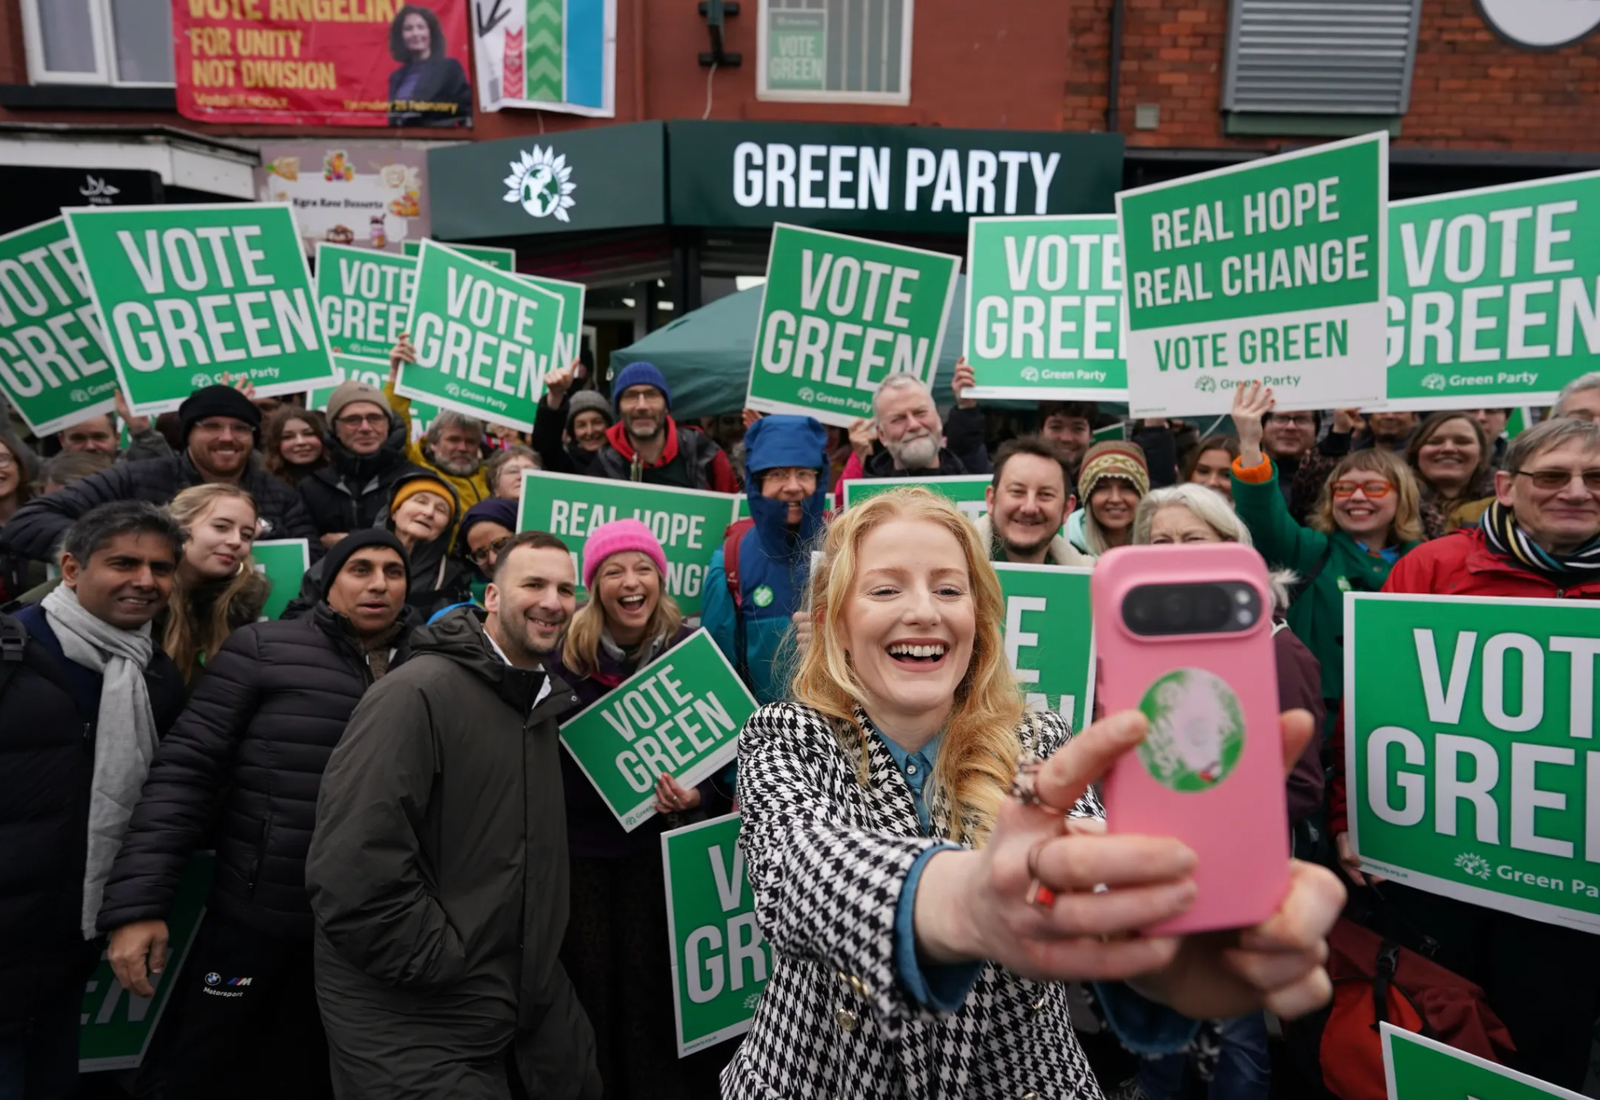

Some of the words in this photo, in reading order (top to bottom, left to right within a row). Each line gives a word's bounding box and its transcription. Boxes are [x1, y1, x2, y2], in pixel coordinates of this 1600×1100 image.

[188, 0, 264, 20] VOTE
[190, 27, 234, 56] FOR
[236, 28, 303, 58] UNITY
[770, 57, 823, 80] GREEN
[778, 35, 815, 56] VOTE
[191, 59, 236, 87] NOT
[241, 60, 337, 90] DIVISION
[733, 141, 891, 210] GREEN
[905, 147, 1061, 215] PARTY
[1152, 202, 1234, 253] REAL
[1243, 176, 1340, 236] HOPE
[1400, 200, 1578, 288] VOTE
[0, 237, 91, 328] OTE
[116, 225, 275, 294] VOTE
[339, 257, 416, 304] VOTE
[801, 248, 920, 329] VOTE
[1005, 234, 1122, 291] VOTE
[1133, 261, 1213, 309] REAL
[1221, 234, 1369, 297] CHANGE
[112, 288, 320, 373] GREEN
[447, 266, 538, 346] VOTE
[975, 296, 1127, 360] GREE
[414, 311, 548, 404] GREEN
[761, 309, 930, 392] GREEN
[1153, 331, 1229, 372] VOTE
[1239, 318, 1349, 365] GREEN
[213, 372, 249, 385] Geen
[250, 366, 280, 380] Party
[460, 388, 486, 404] Green
[486, 395, 508, 412] Party
[816, 392, 845, 406] Green
[846, 396, 873, 414] Party
[1041, 369, 1074, 380] Green
[1077, 369, 1106, 383] Party
[1263, 374, 1301, 388] Party
[1449, 374, 1493, 387] Green
[1497, 371, 1538, 386] Party
[600, 663, 694, 743] VOTE
[1413, 628, 1600, 739] VOT
[615, 690, 737, 794] GREEN
[1367, 725, 1600, 864] GRE
[1496, 865, 1564, 891] Green
[203, 986, 244, 998] Motorsport
